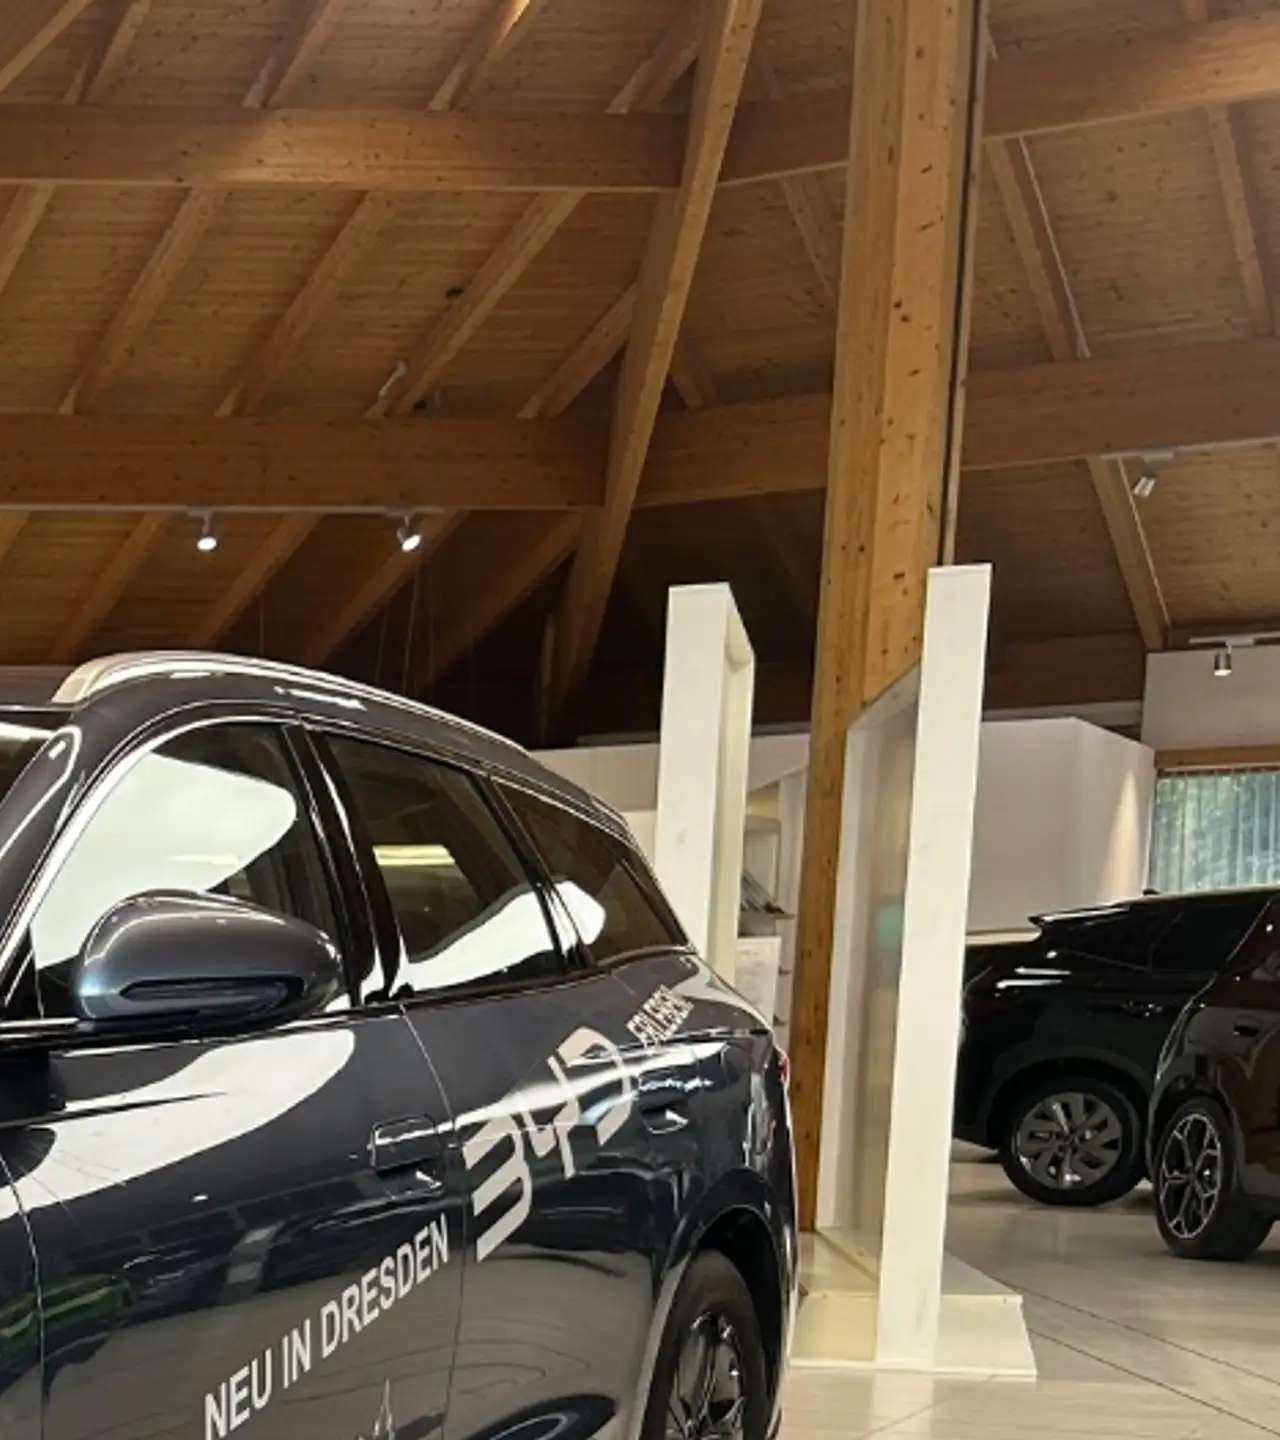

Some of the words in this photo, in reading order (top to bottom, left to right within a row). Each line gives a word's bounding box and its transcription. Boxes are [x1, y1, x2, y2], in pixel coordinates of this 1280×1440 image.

[462, 1026, 632, 1263] BYD
[282, 1318, 311, 1389] IN
[320, 1212, 448, 1358] DRESDEN
